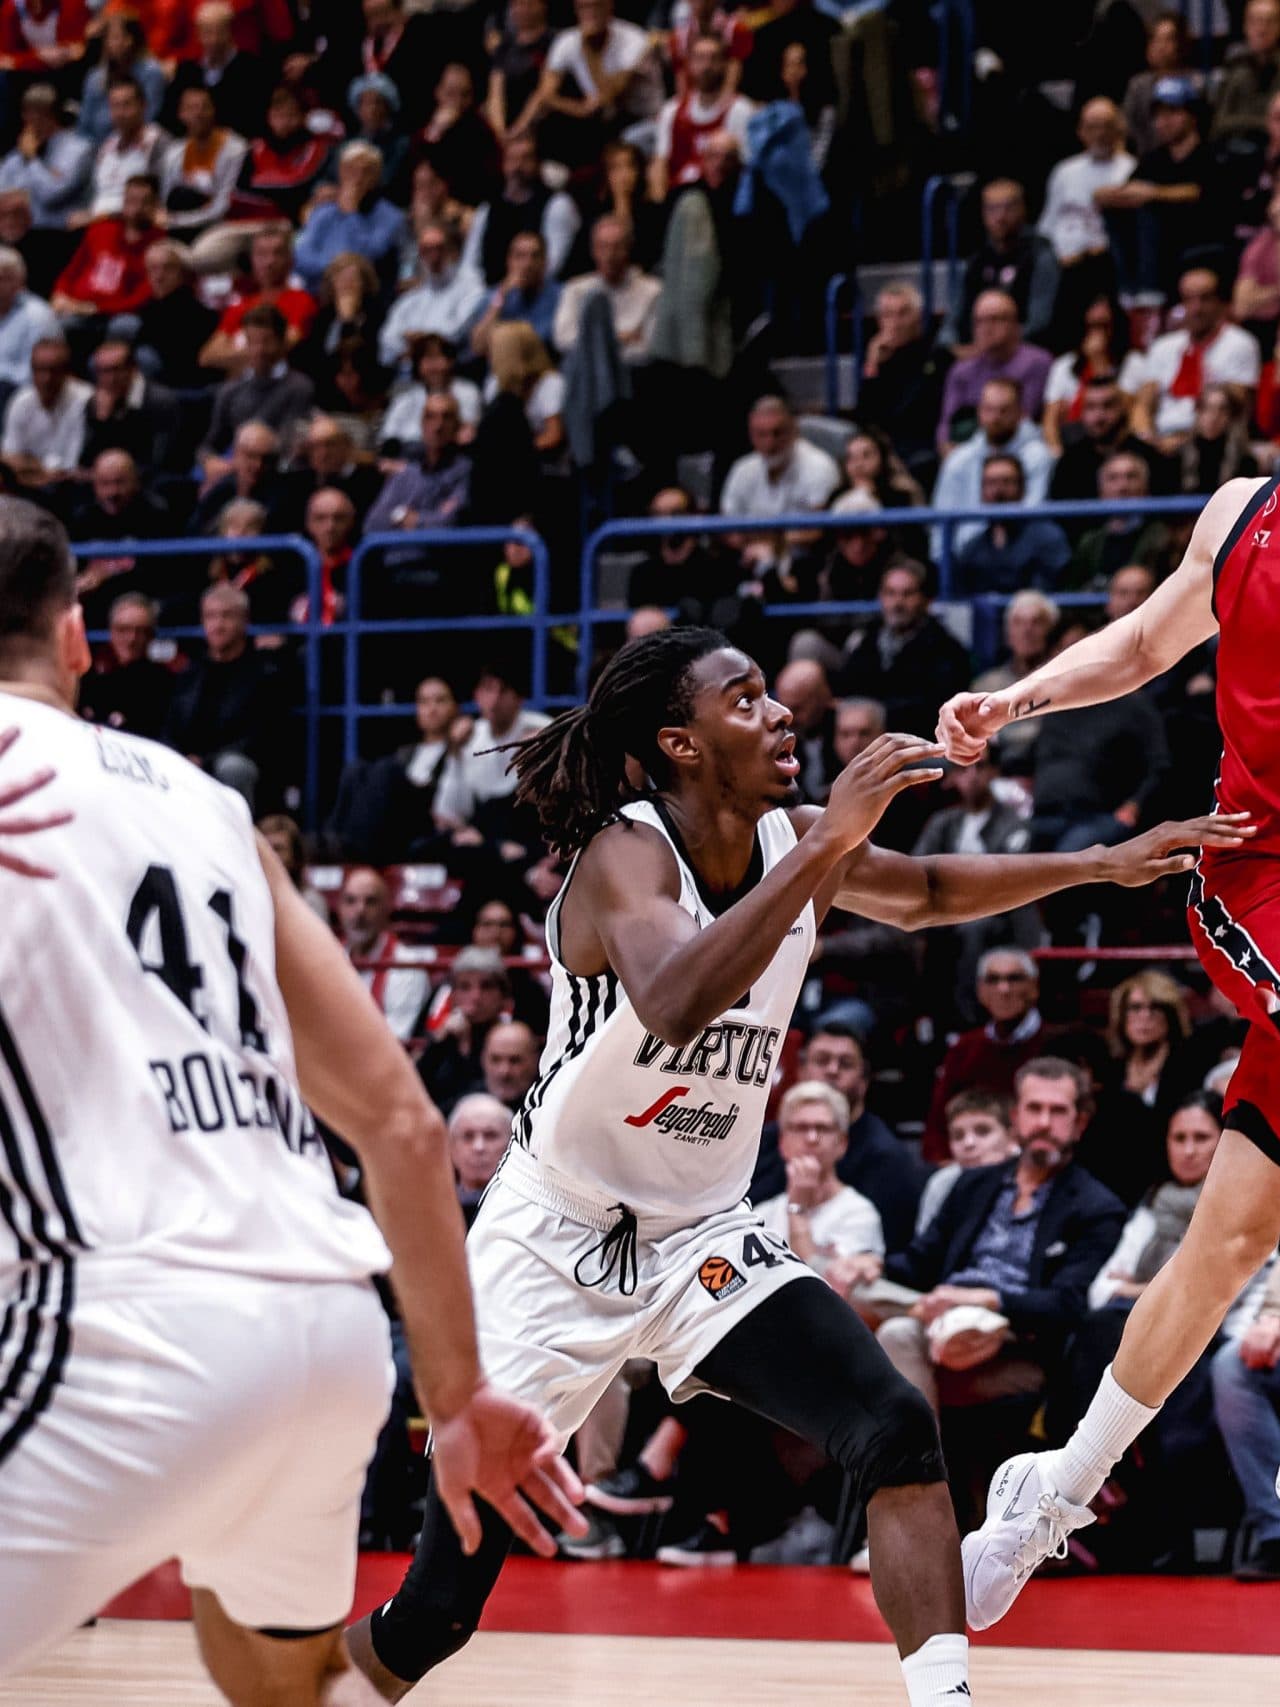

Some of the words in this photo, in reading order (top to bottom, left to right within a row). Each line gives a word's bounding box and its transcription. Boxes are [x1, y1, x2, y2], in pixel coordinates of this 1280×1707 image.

[126, 864, 268, 1054] 41
[624, 1086, 738, 1140] Segafredo
[673, 1132, 711, 1148] ZANETTI
